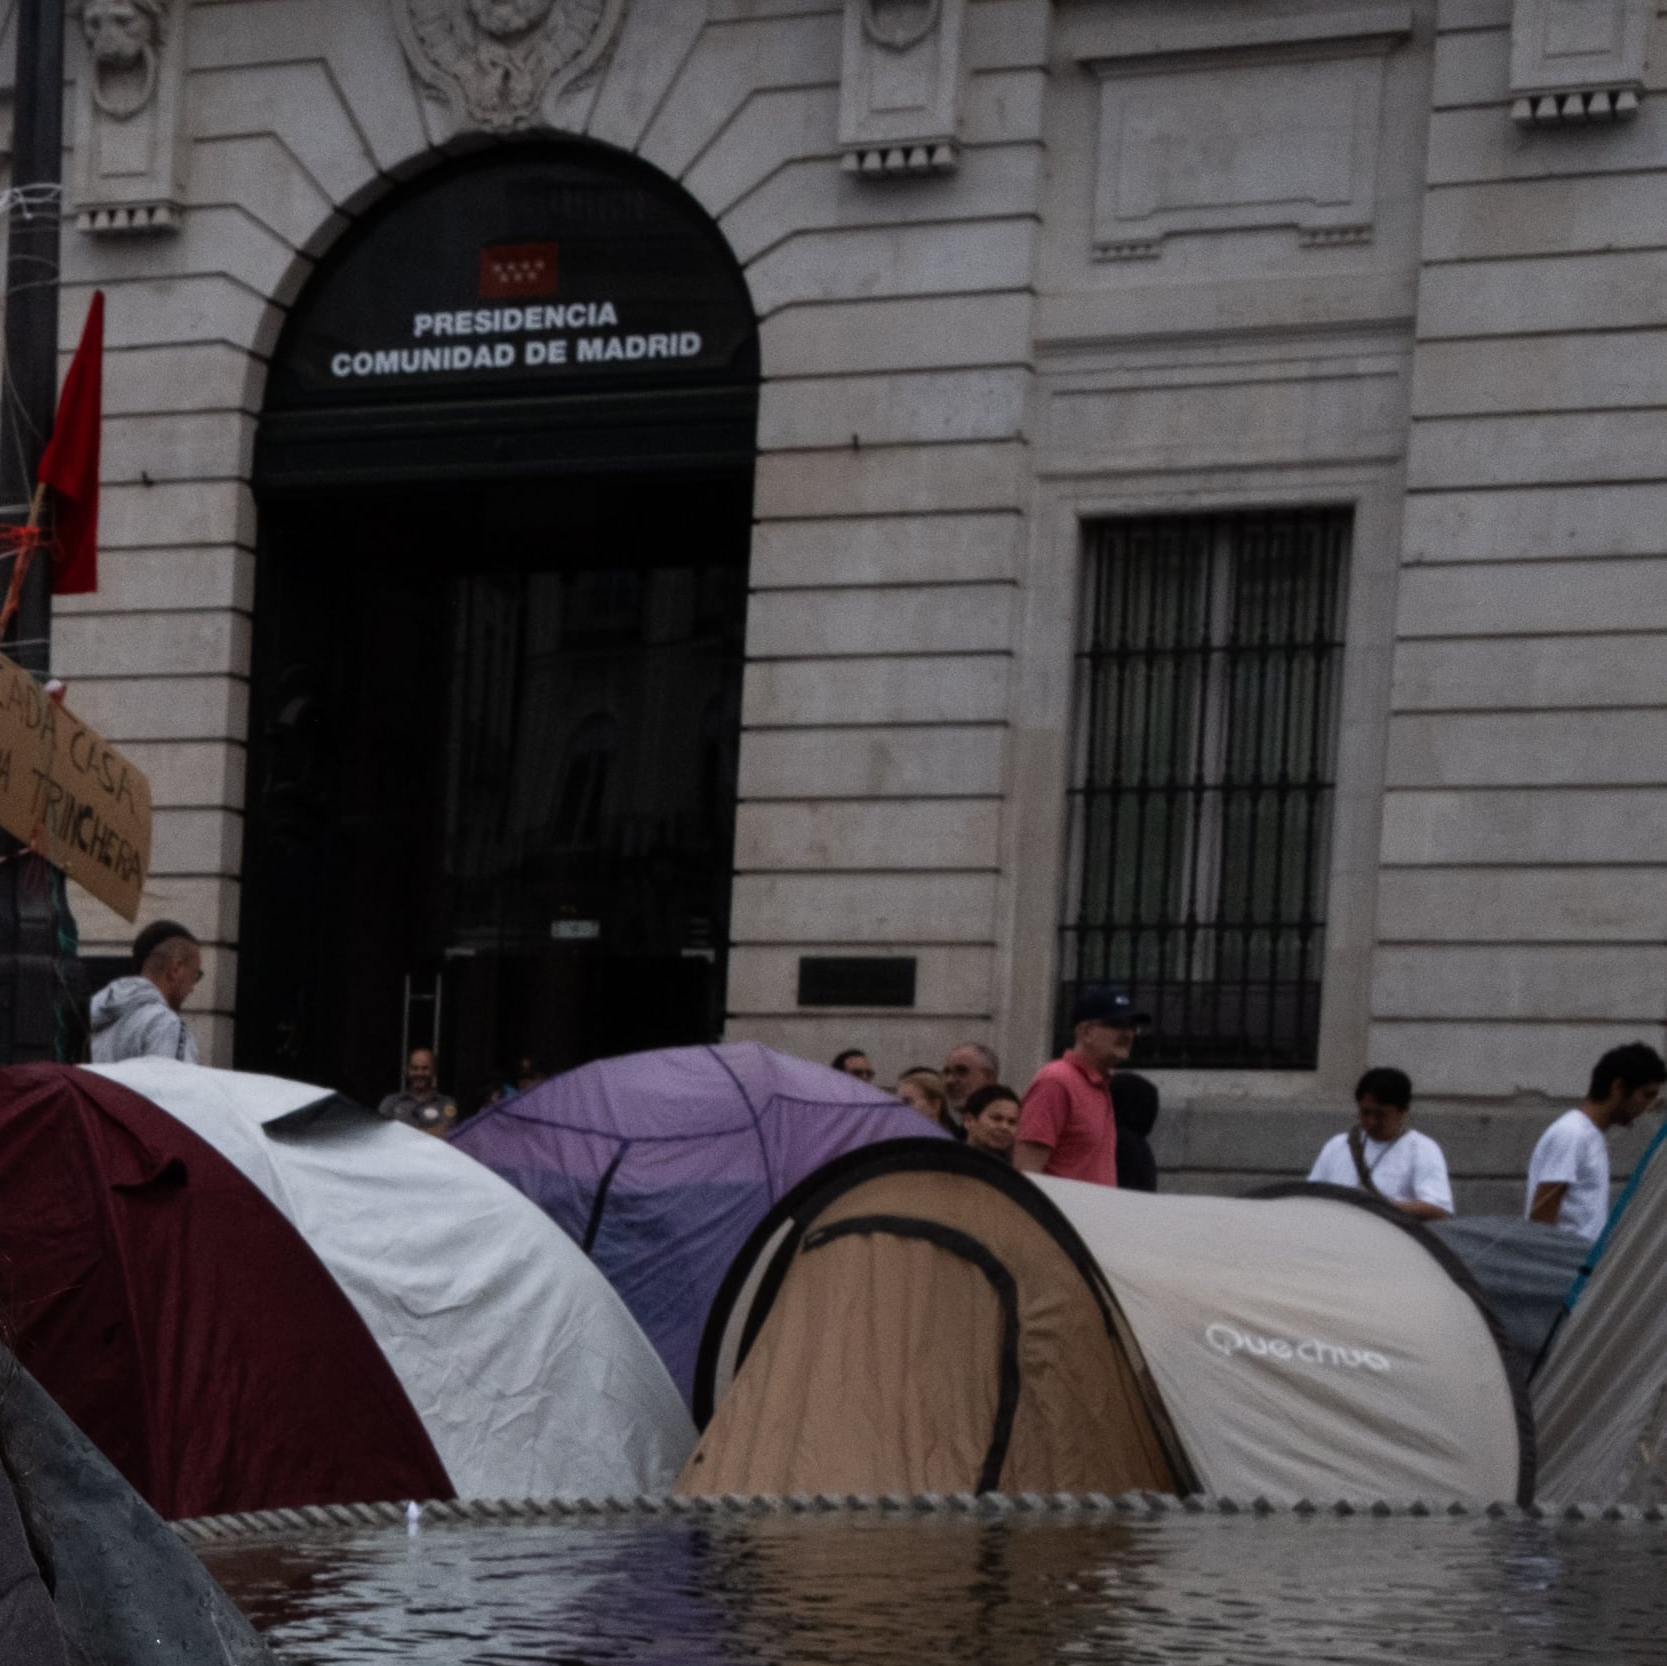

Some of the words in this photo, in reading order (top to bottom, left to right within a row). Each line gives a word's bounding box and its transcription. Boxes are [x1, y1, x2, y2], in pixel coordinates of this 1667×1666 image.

[413, 302, 618, 338] PRESIDENCIA
[331, 341, 515, 377] COMUNIDAD
[525, 342, 567, 365] DE
[577, 332, 702, 362] MADRID
[69, 728, 137, 815] CASA
[31, 768, 144, 890] TRINCHERA
[1205, 1323, 1391, 1371] Quechua
